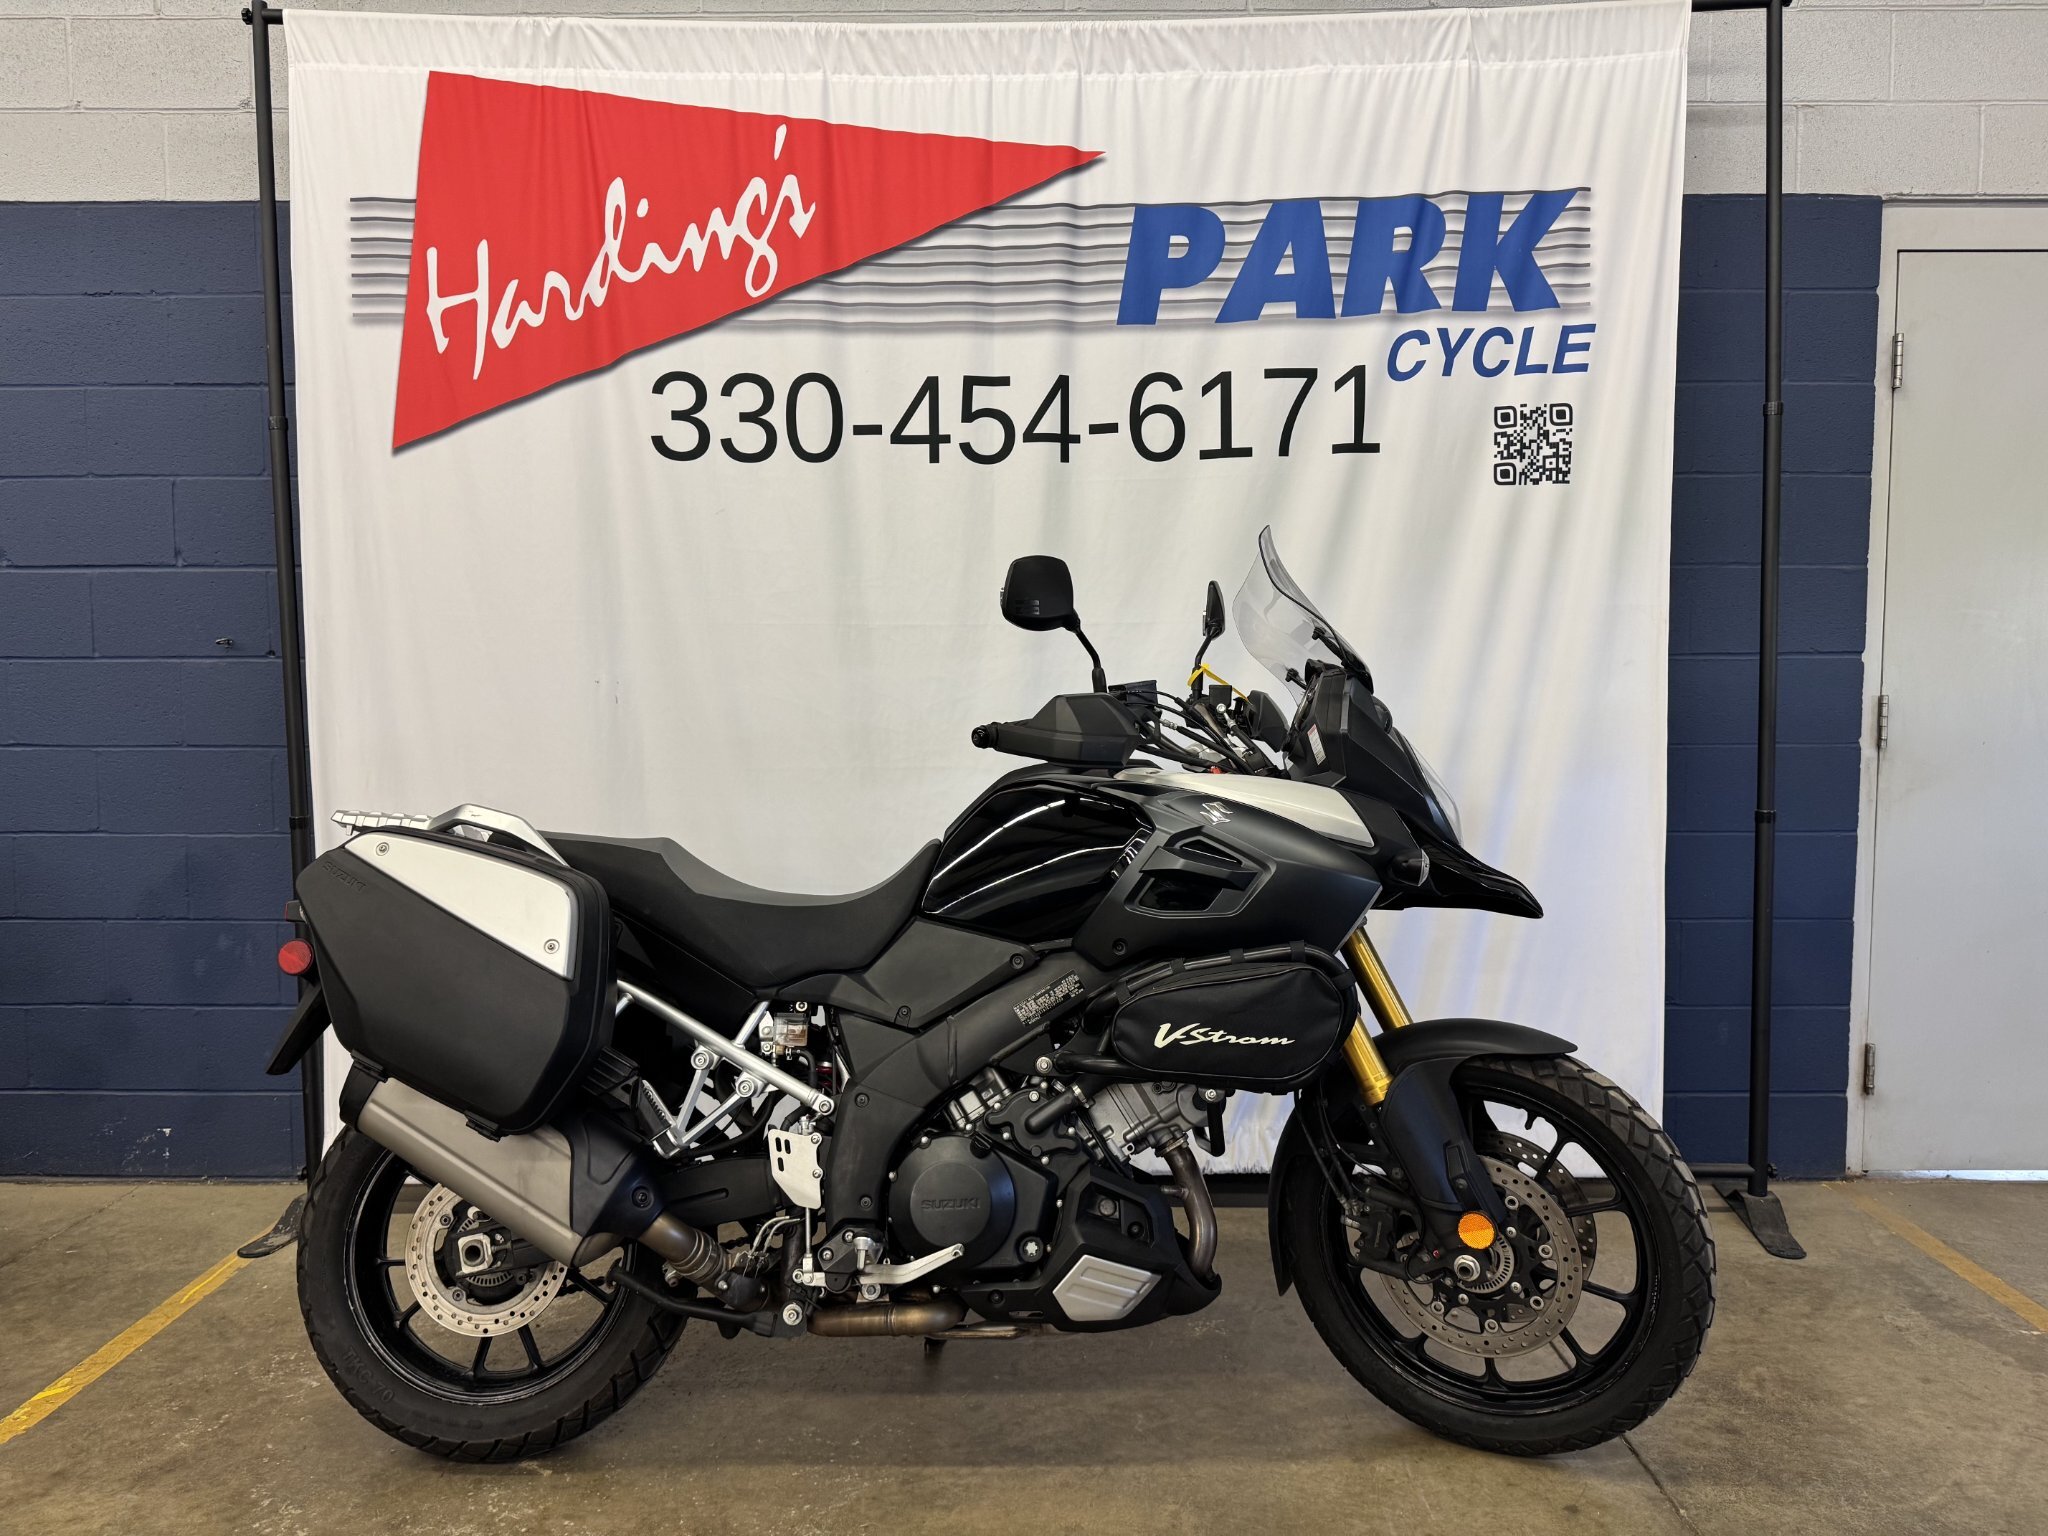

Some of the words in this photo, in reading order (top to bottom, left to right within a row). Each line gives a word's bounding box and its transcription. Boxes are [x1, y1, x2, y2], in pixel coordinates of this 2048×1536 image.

[425, 123, 817, 381] Harding's
[1118, 191, 1580, 326] PARK
[1387, 323, 1596, 381] CYCLE
[650, 364, 1381, 465] 330-454-6171
[920, 1197, 981, 1211] SUZUKI
[372, 1380, 396, 1403] 70
